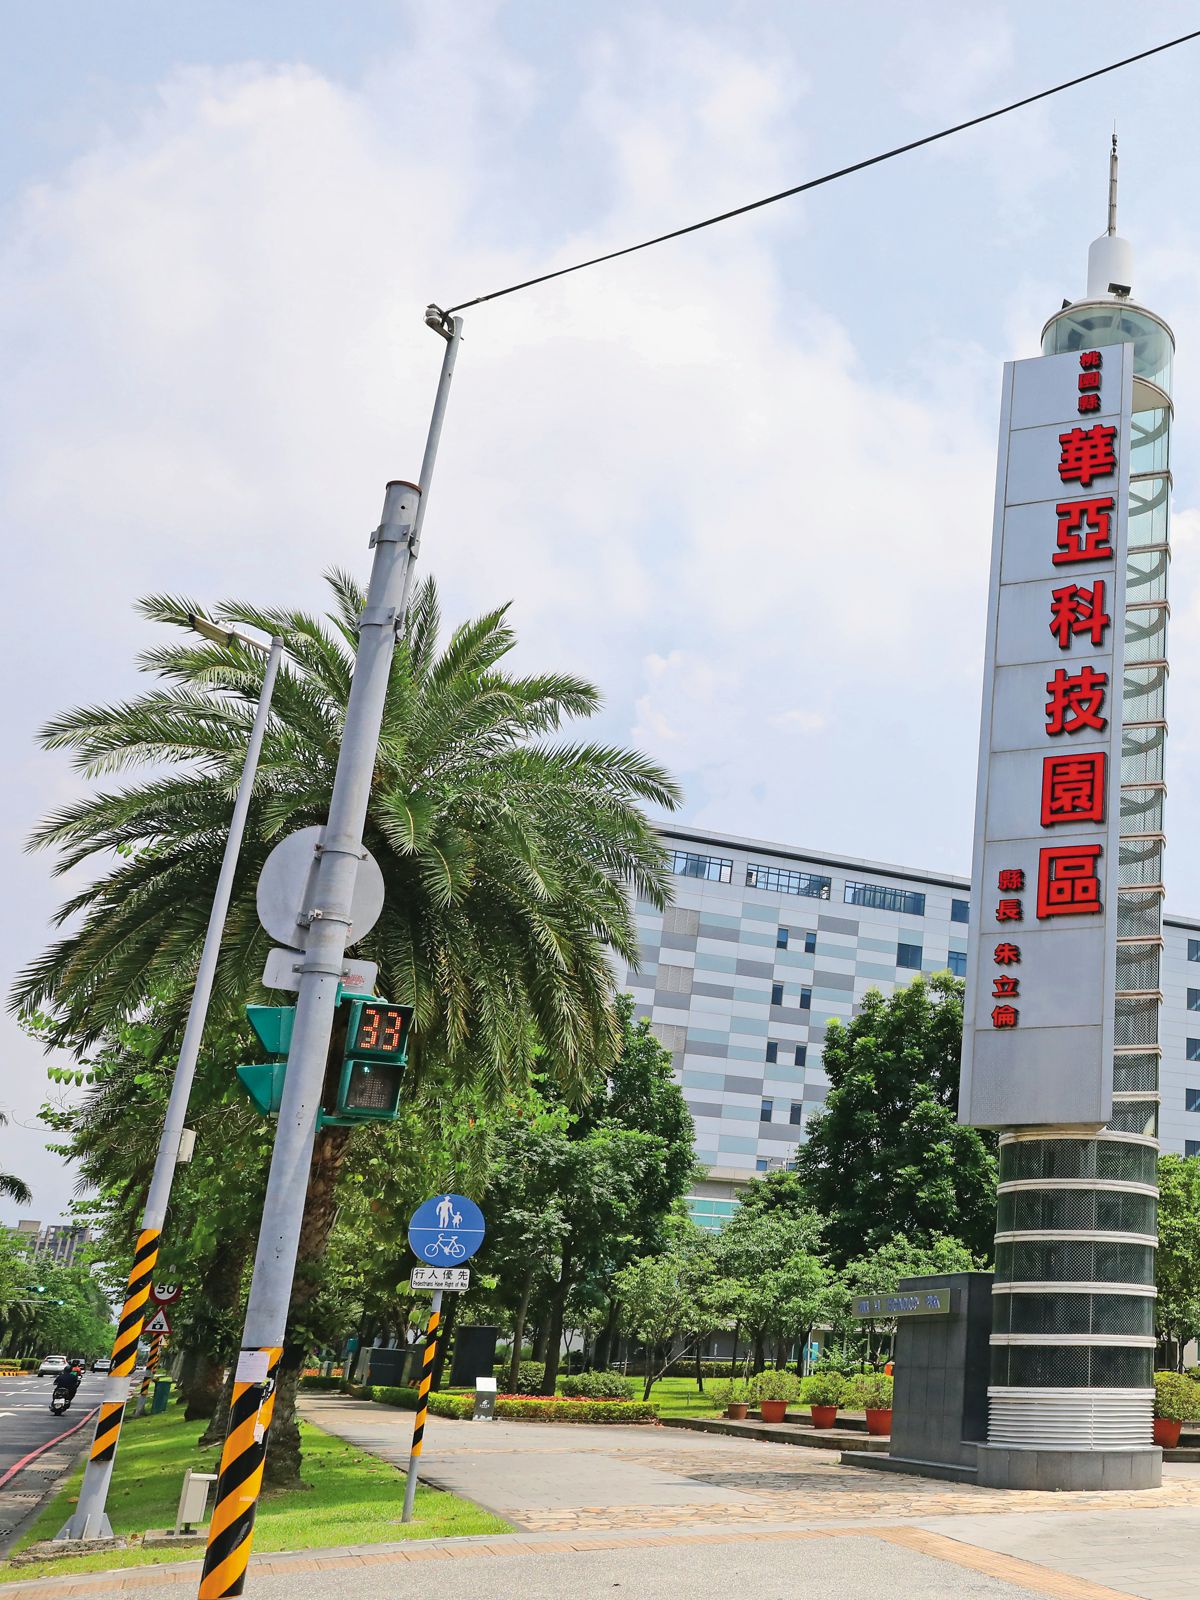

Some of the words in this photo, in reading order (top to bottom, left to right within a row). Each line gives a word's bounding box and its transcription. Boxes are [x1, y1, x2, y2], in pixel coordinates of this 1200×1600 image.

[1036, 424, 1118, 920] 華亞科技園區
[360, 1009, 402, 1050] 33
[414, 1269, 468, 1280] 行人優先
